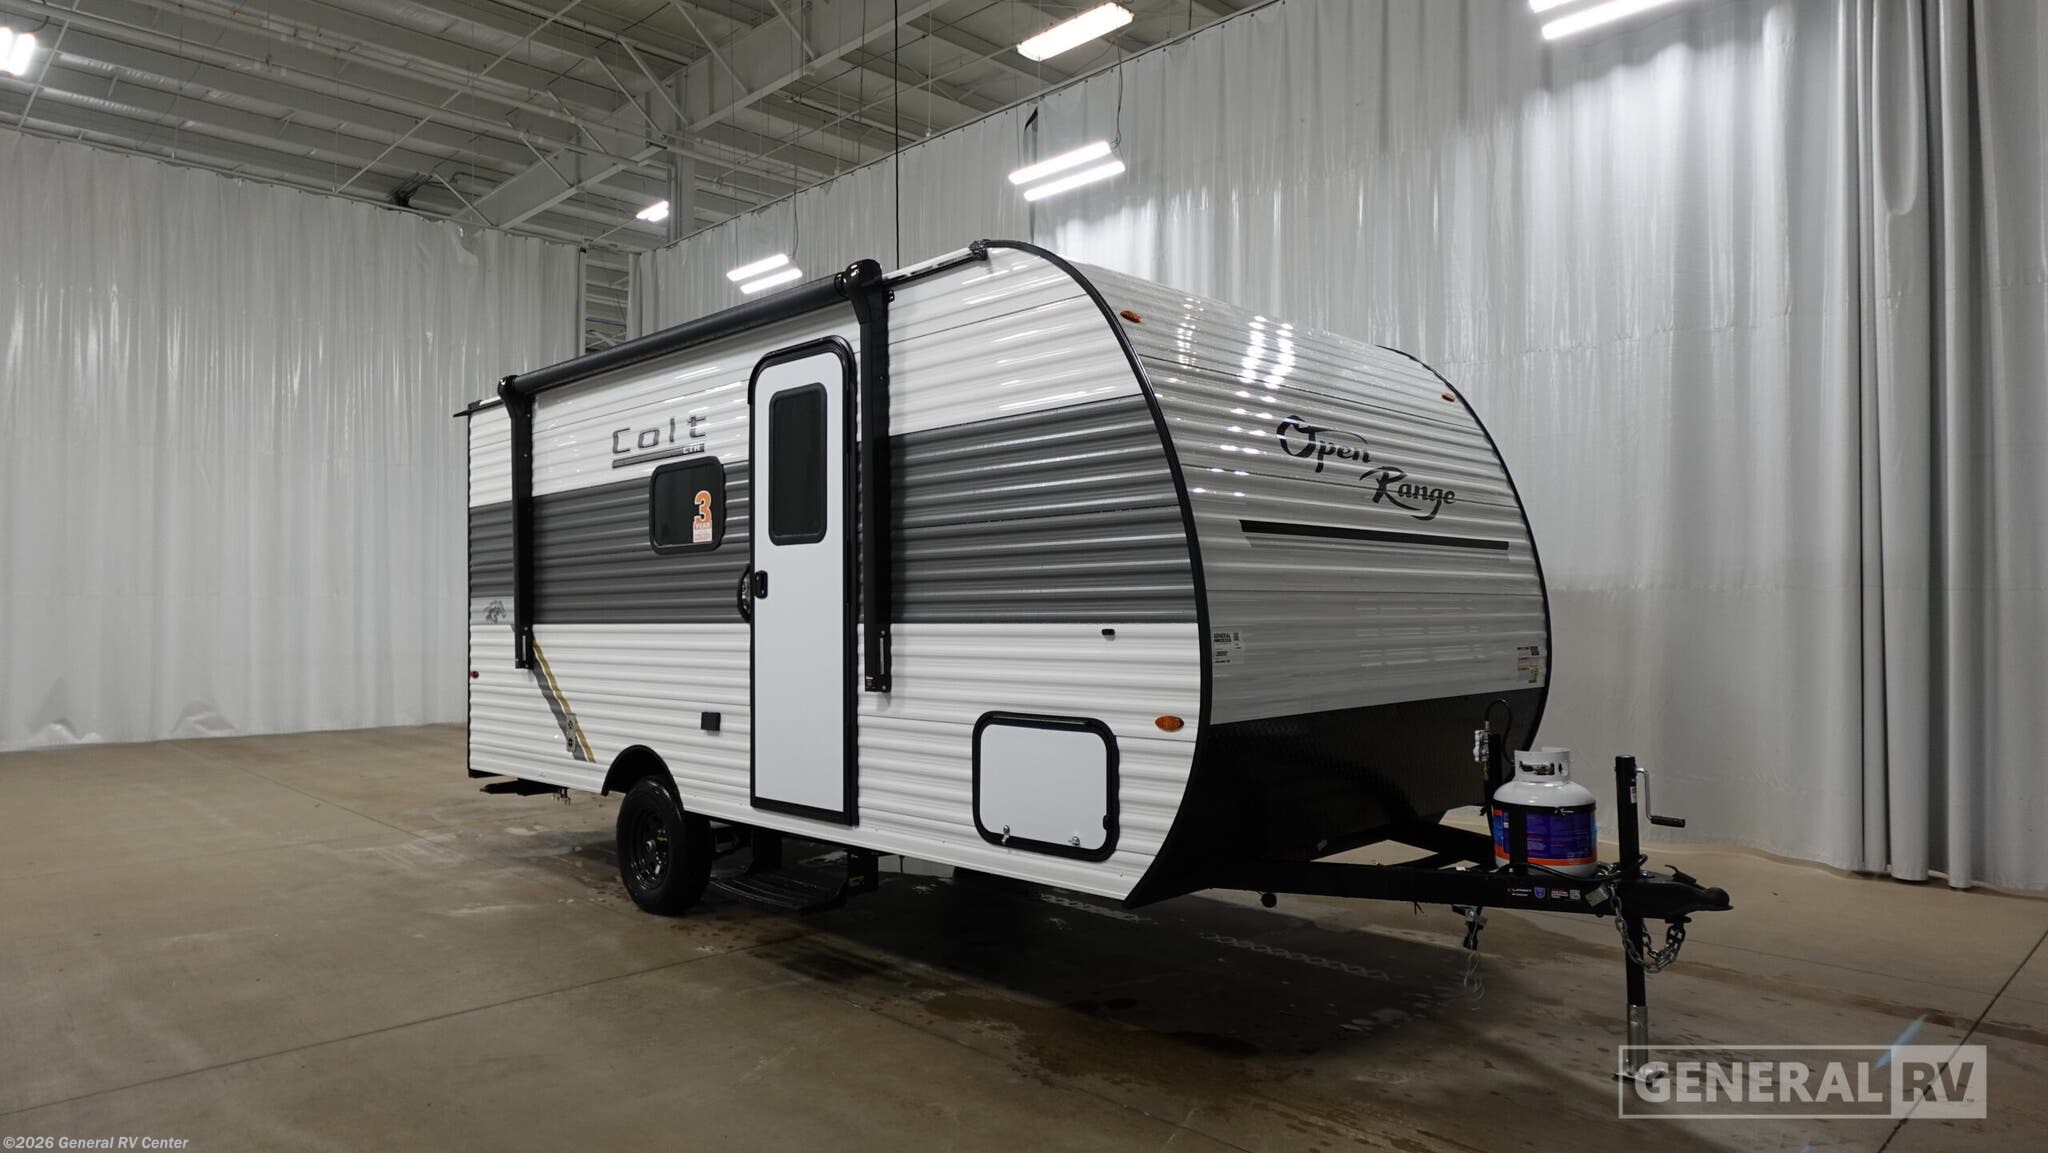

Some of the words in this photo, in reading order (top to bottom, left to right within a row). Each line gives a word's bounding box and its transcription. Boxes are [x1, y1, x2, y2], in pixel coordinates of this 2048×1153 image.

[612, 416, 706, 454] Colt
[1276, 415, 1372, 473] Open
[1360, 466, 1456, 520] Range
[694, 490, 712, 523] 3
